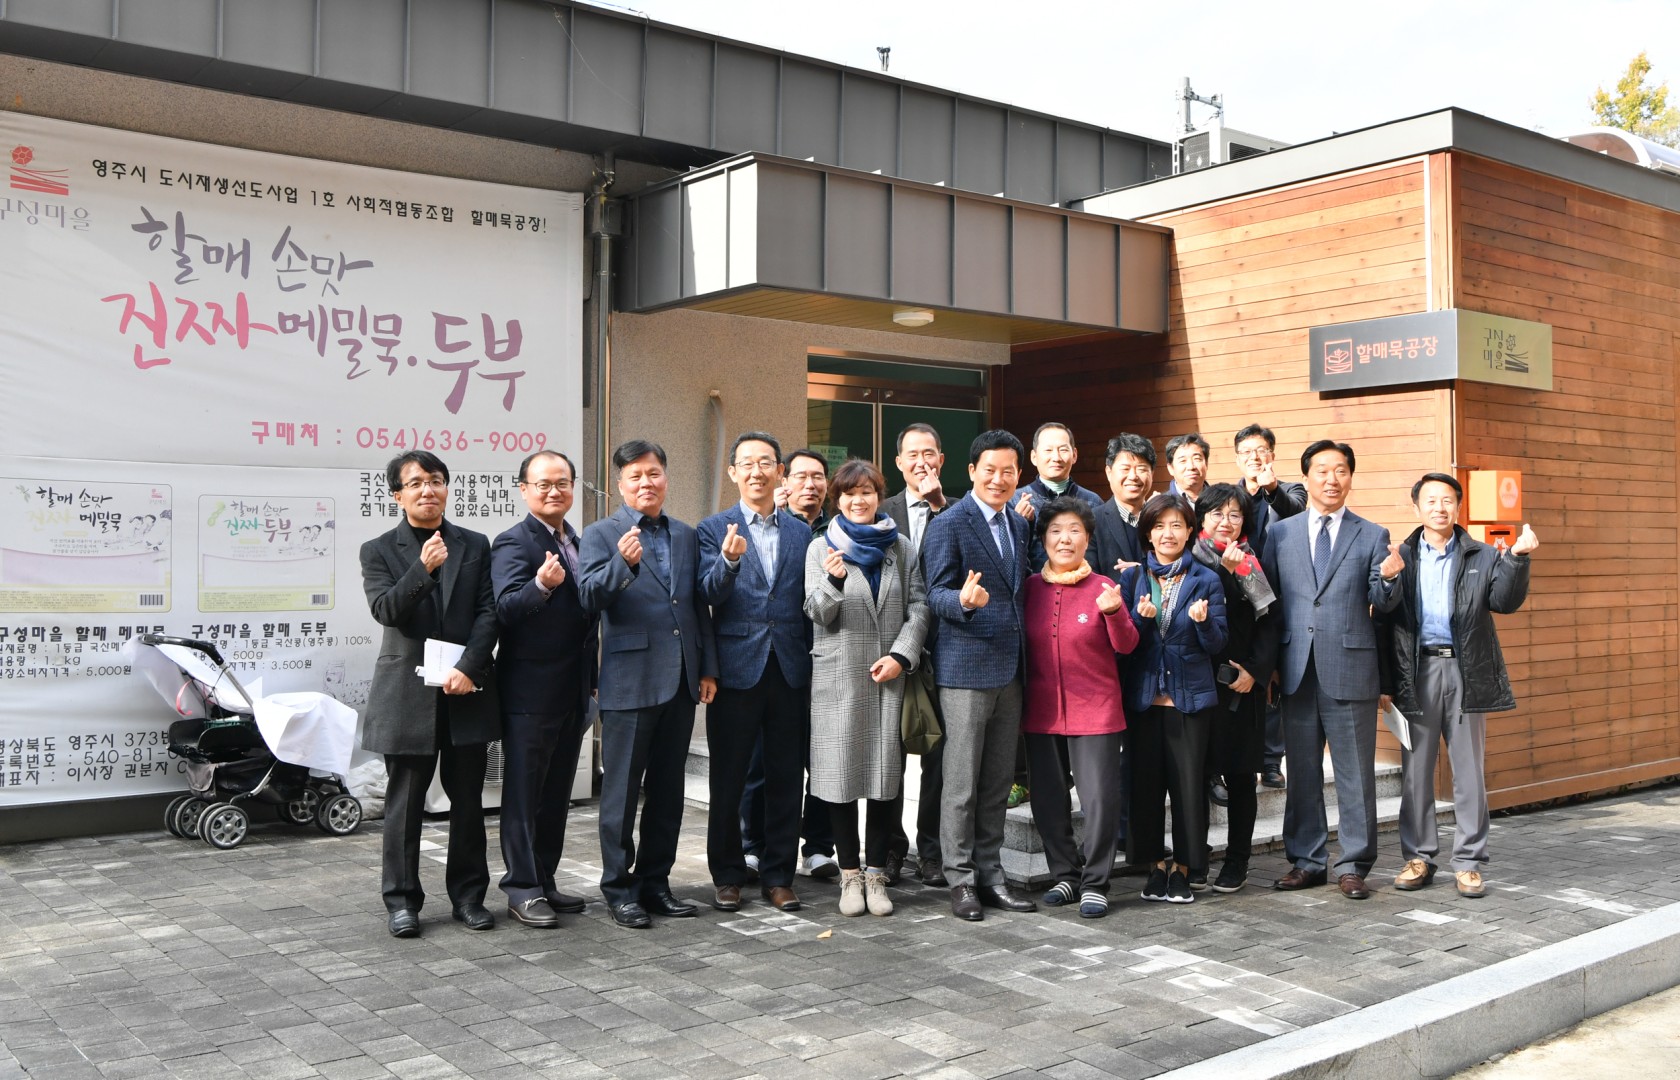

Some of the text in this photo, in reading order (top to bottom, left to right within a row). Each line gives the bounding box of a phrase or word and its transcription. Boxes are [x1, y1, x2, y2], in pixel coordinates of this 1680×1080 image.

[92, 159, 547, 233] 영주시 도시재생선도사업 1호 사회적협동조합 할매묵공장!
[131, 206, 374, 297] 할매 손맛
[101, 280, 279, 369] 진짜
[1356, 336, 1438, 363] 할매묵공장
[251, 421, 318, 447] 구매처
[356, 426, 547, 452] 054)636-9009
[454, 474, 503, 488] 사용하여
[36, 486, 113, 509] 할매 손맛
[454, 490, 478, 502] 맛을
[230, 500, 289, 517] 할매 손맛
[79, 511, 122, 533] 메밀묵
[263, 517, 291, 543] 두부
[76, 626, 107, 641] 할매
[191, 622, 327, 639] 구성마을 할매 두부
[55, 643, 83, 653] 1등급
[345, 636, 372, 645] 100%
[233, 650, 263, 660] 500g
[68, 734, 114, 750] 영주시
[67, 765, 113, 782] 이사장
[124, 761, 168, 778] 권분자
